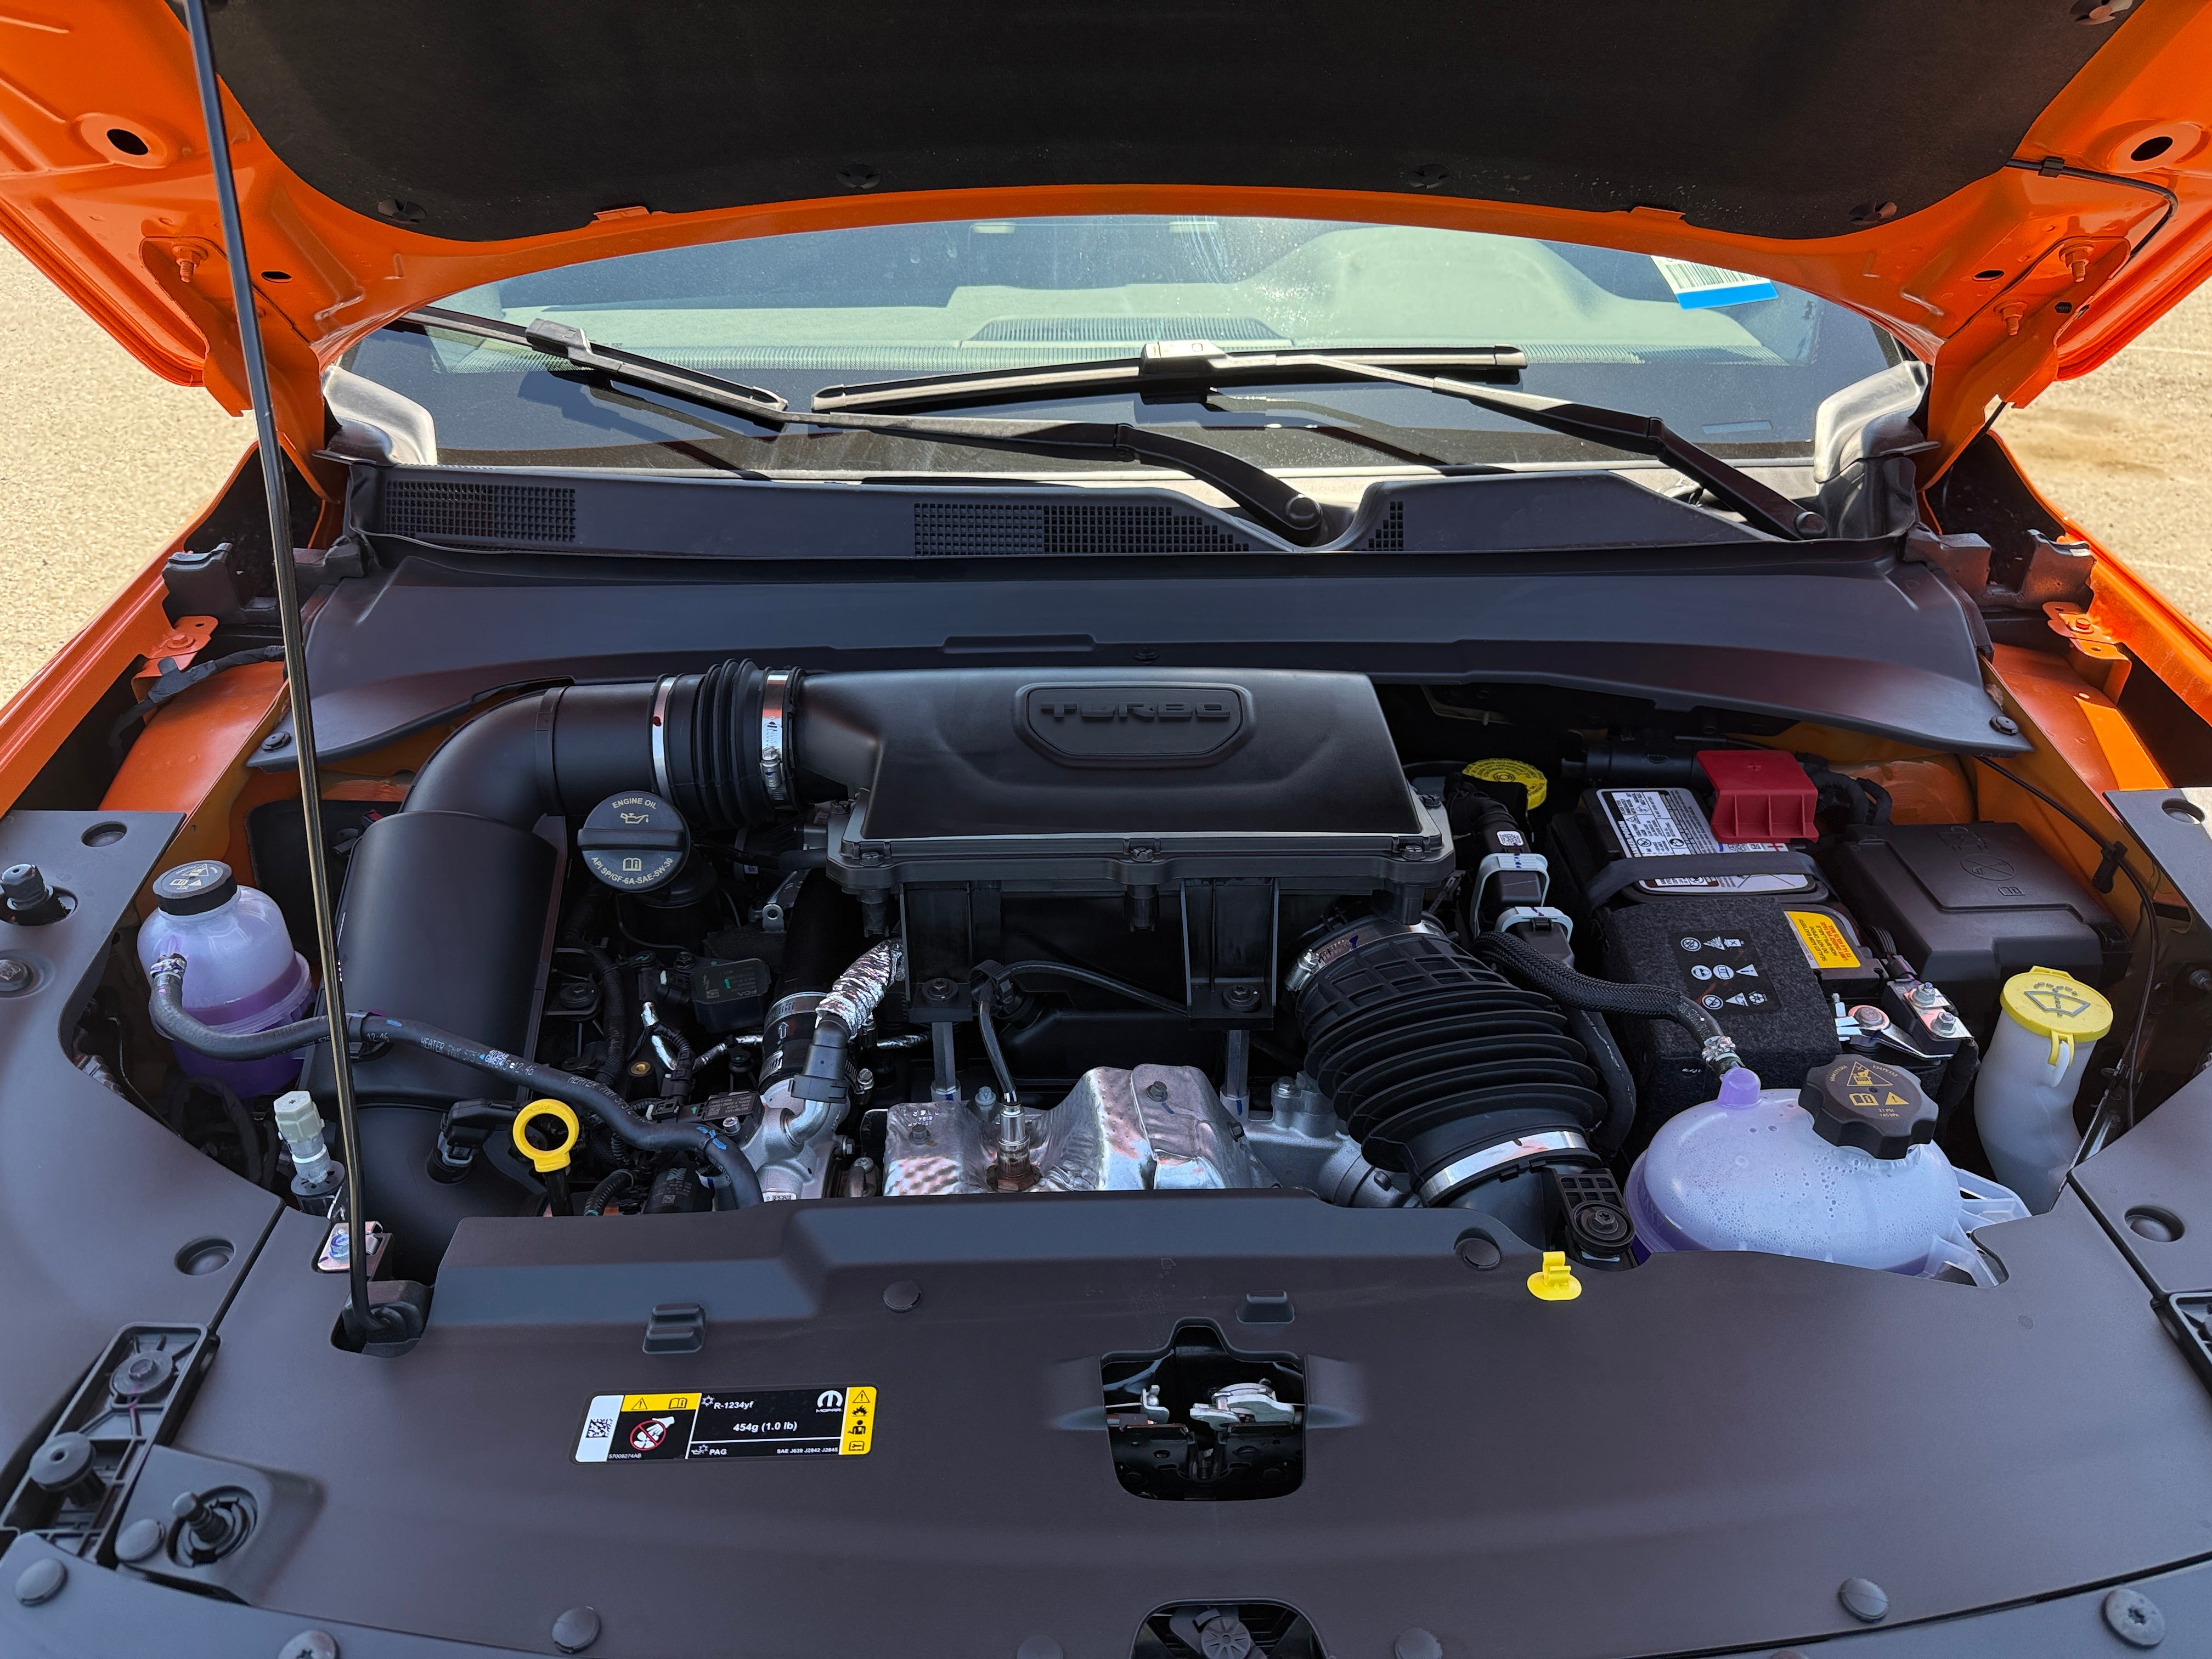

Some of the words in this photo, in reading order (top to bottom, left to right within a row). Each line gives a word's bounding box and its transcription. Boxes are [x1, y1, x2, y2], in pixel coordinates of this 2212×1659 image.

[1041, 702, 1231, 718] TURBO
[612, 798, 643, 809] ENGINE
[645, 800, 657, 809] OIL
[591, 856, 601, 870] API
[1797, 918, 1812, 936] BATTERY
[1815, 925, 1838, 956] NON-SPILLABLE
[1815, 939, 1825, 947] NOT
[1813, 946, 1827, 961] SEALED
[420, 1036, 445, 1053] HEATER
[713, 1401, 754, 1410] R-1234yf
[733, 1423, 759, 1432] 454g
[761, 1422, 781, 1432] (1.0
[783, 1421, 798, 1431] lb)
